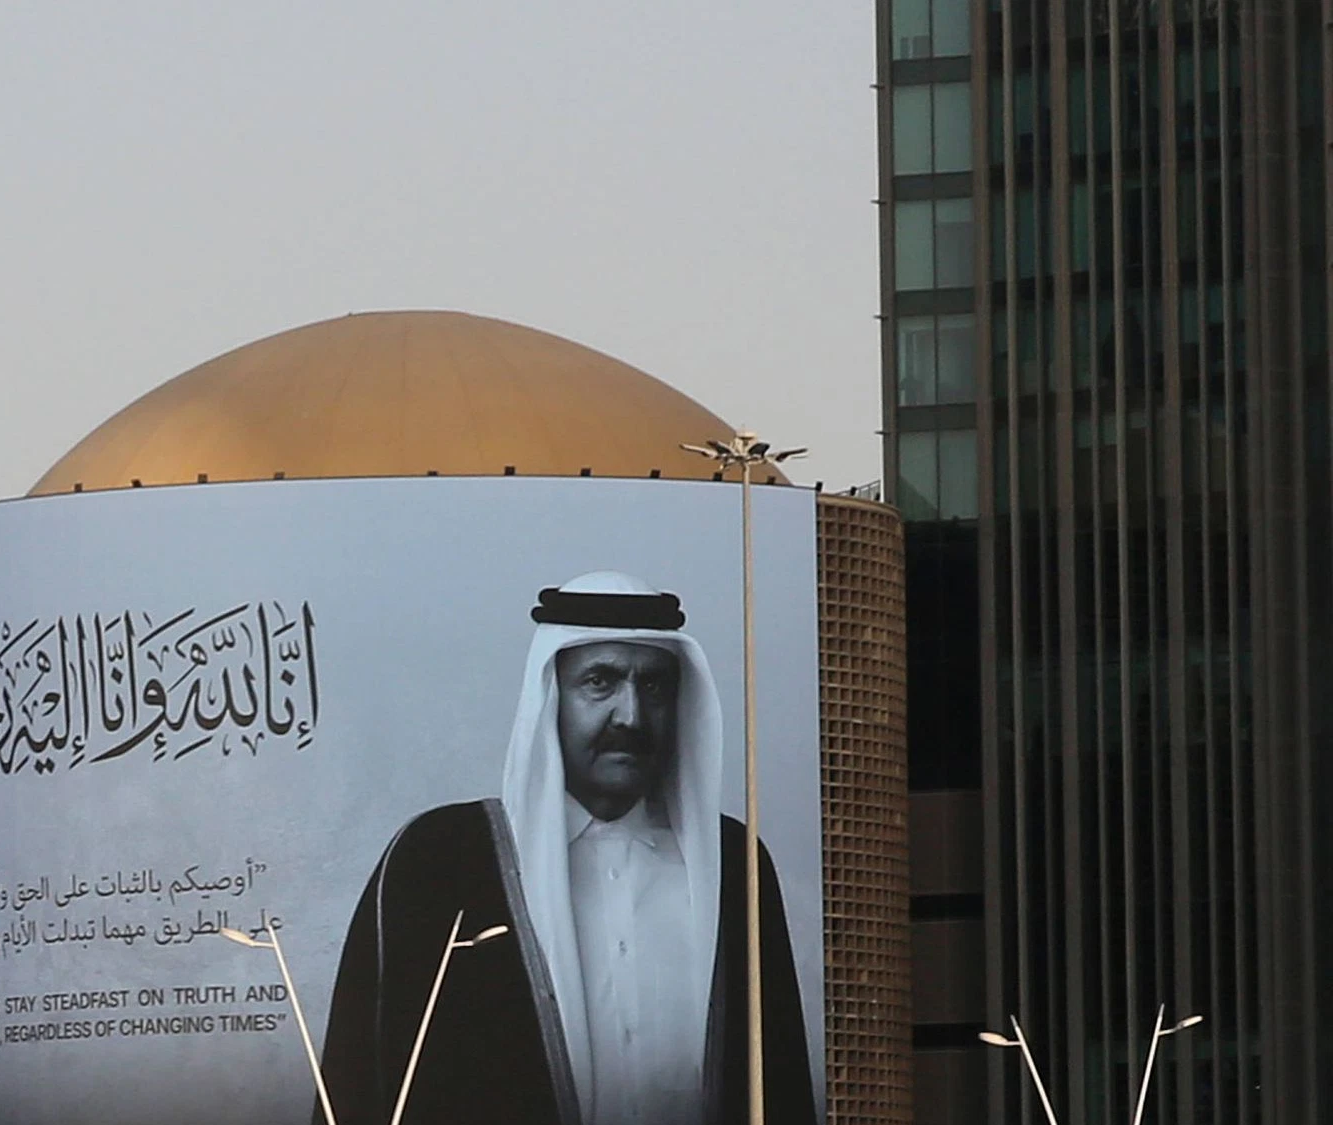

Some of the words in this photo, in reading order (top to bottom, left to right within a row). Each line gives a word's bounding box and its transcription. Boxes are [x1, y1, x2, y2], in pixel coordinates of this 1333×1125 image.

[12, 876, 51, 912] الحق
[54, 873, 90, 908] على
[95, 868, 162, 902] بالثبات
[41, 917, 96, 950] تبدلت
[102, 915, 146, 946] مهما
[5, 995, 38, 1015] STAY
[42, 990, 130, 1012] STEADFAST
[137, 988, 165, 1006] ON
[172, 986, 236, 1004] TRUTH
[244, 984, 289, 1002] AND
[4, 1019, 93, 1043] REGARDLESS
[94, 1020, 116, 1037] OF
[119, 1015, 215, 1037] CHANGING
